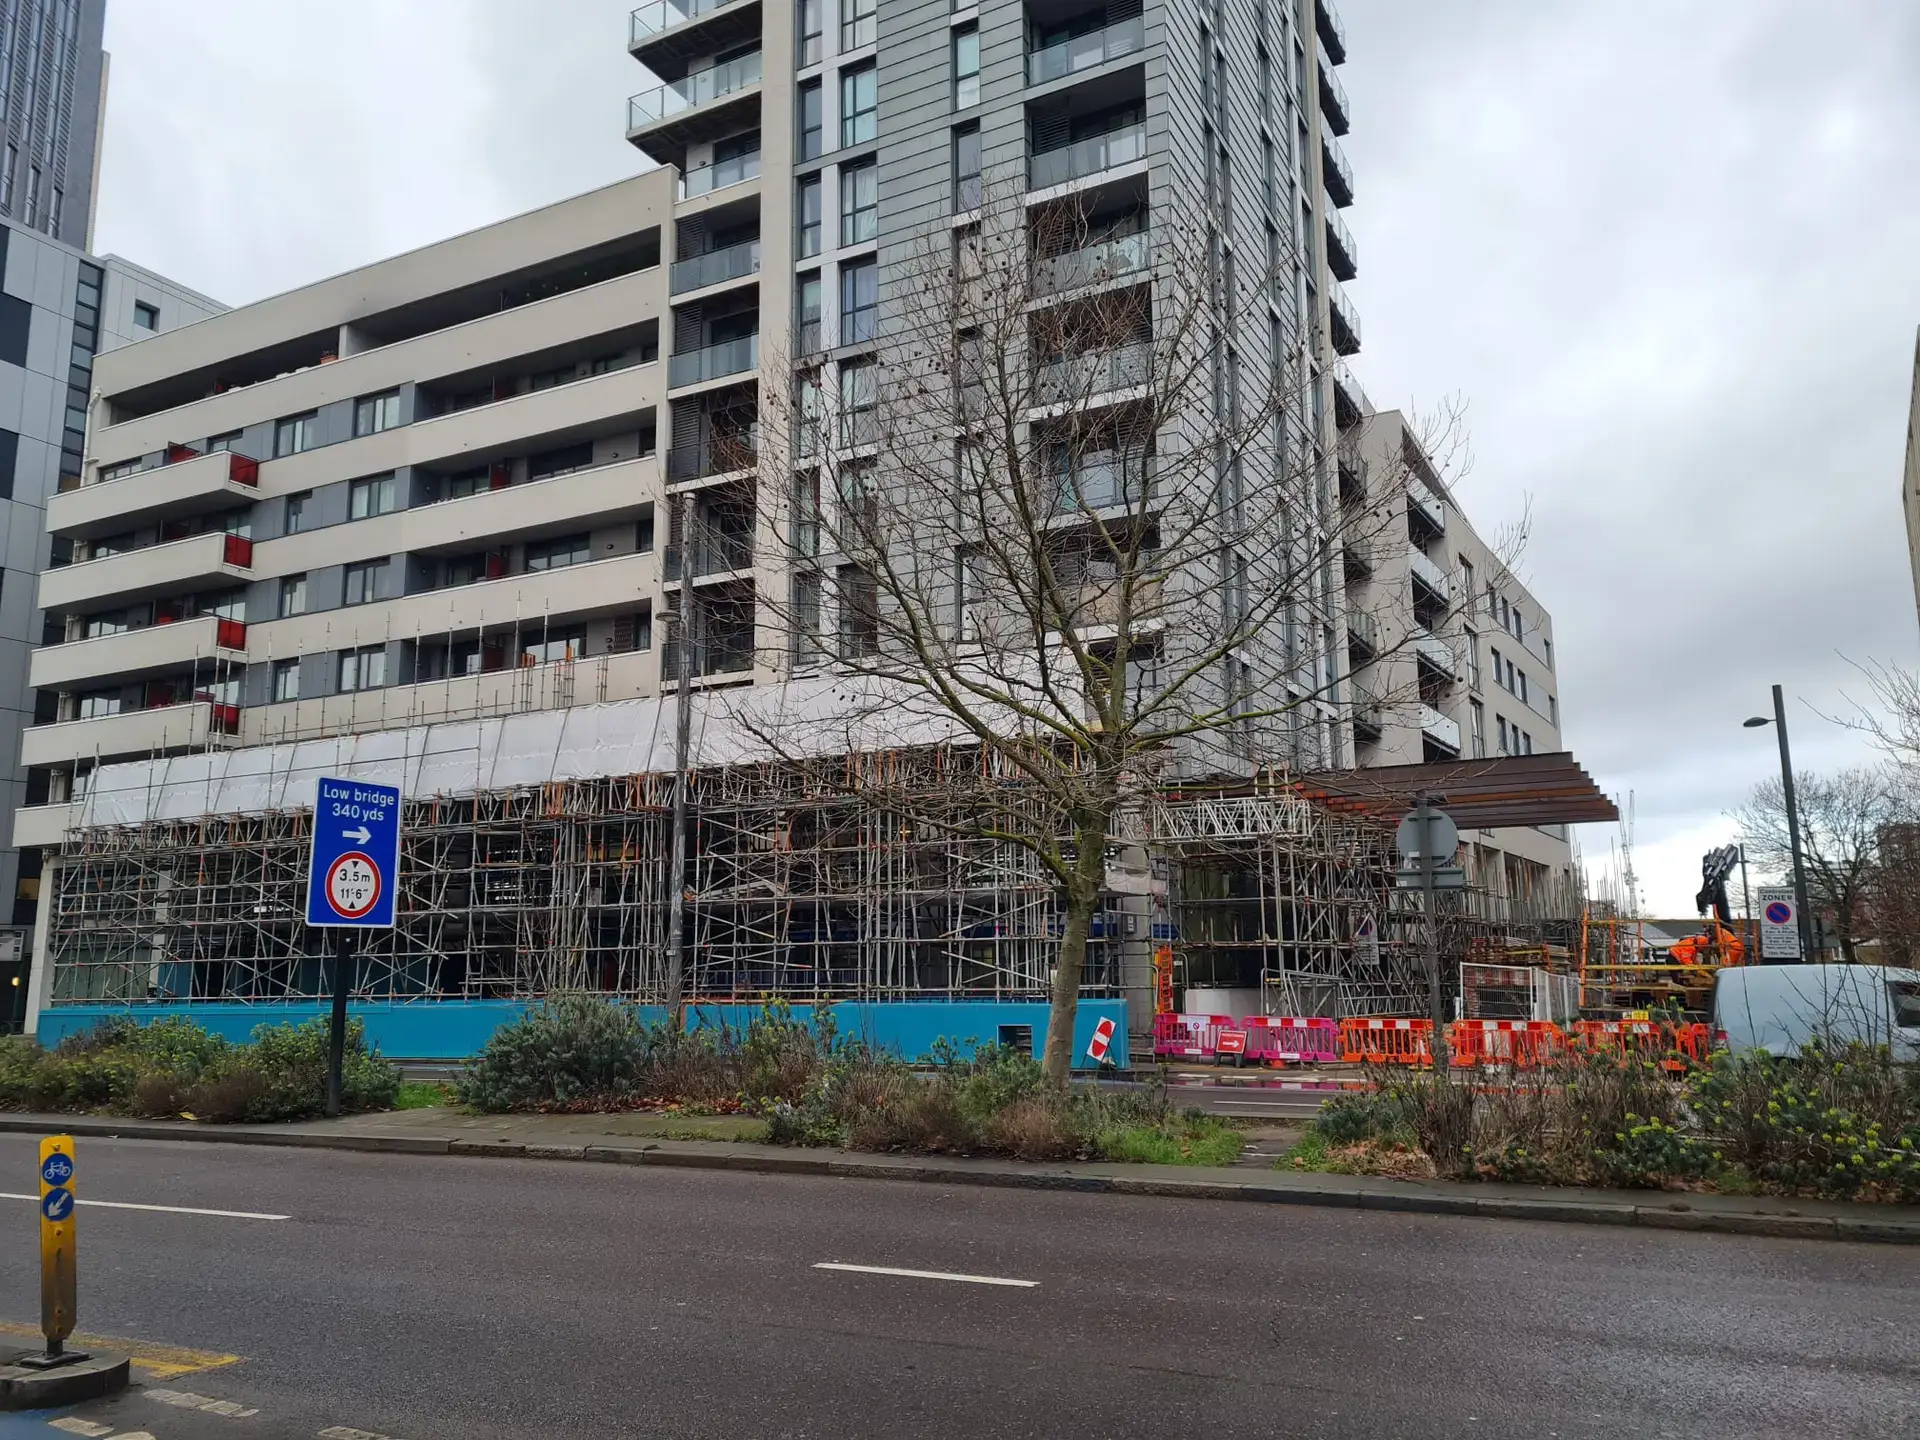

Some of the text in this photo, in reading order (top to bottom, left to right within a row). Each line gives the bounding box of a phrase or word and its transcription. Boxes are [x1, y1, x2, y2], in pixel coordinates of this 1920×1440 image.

[323, 784, 395, 807] Low bridge
[332, 803, 384, 822] 340 yds
